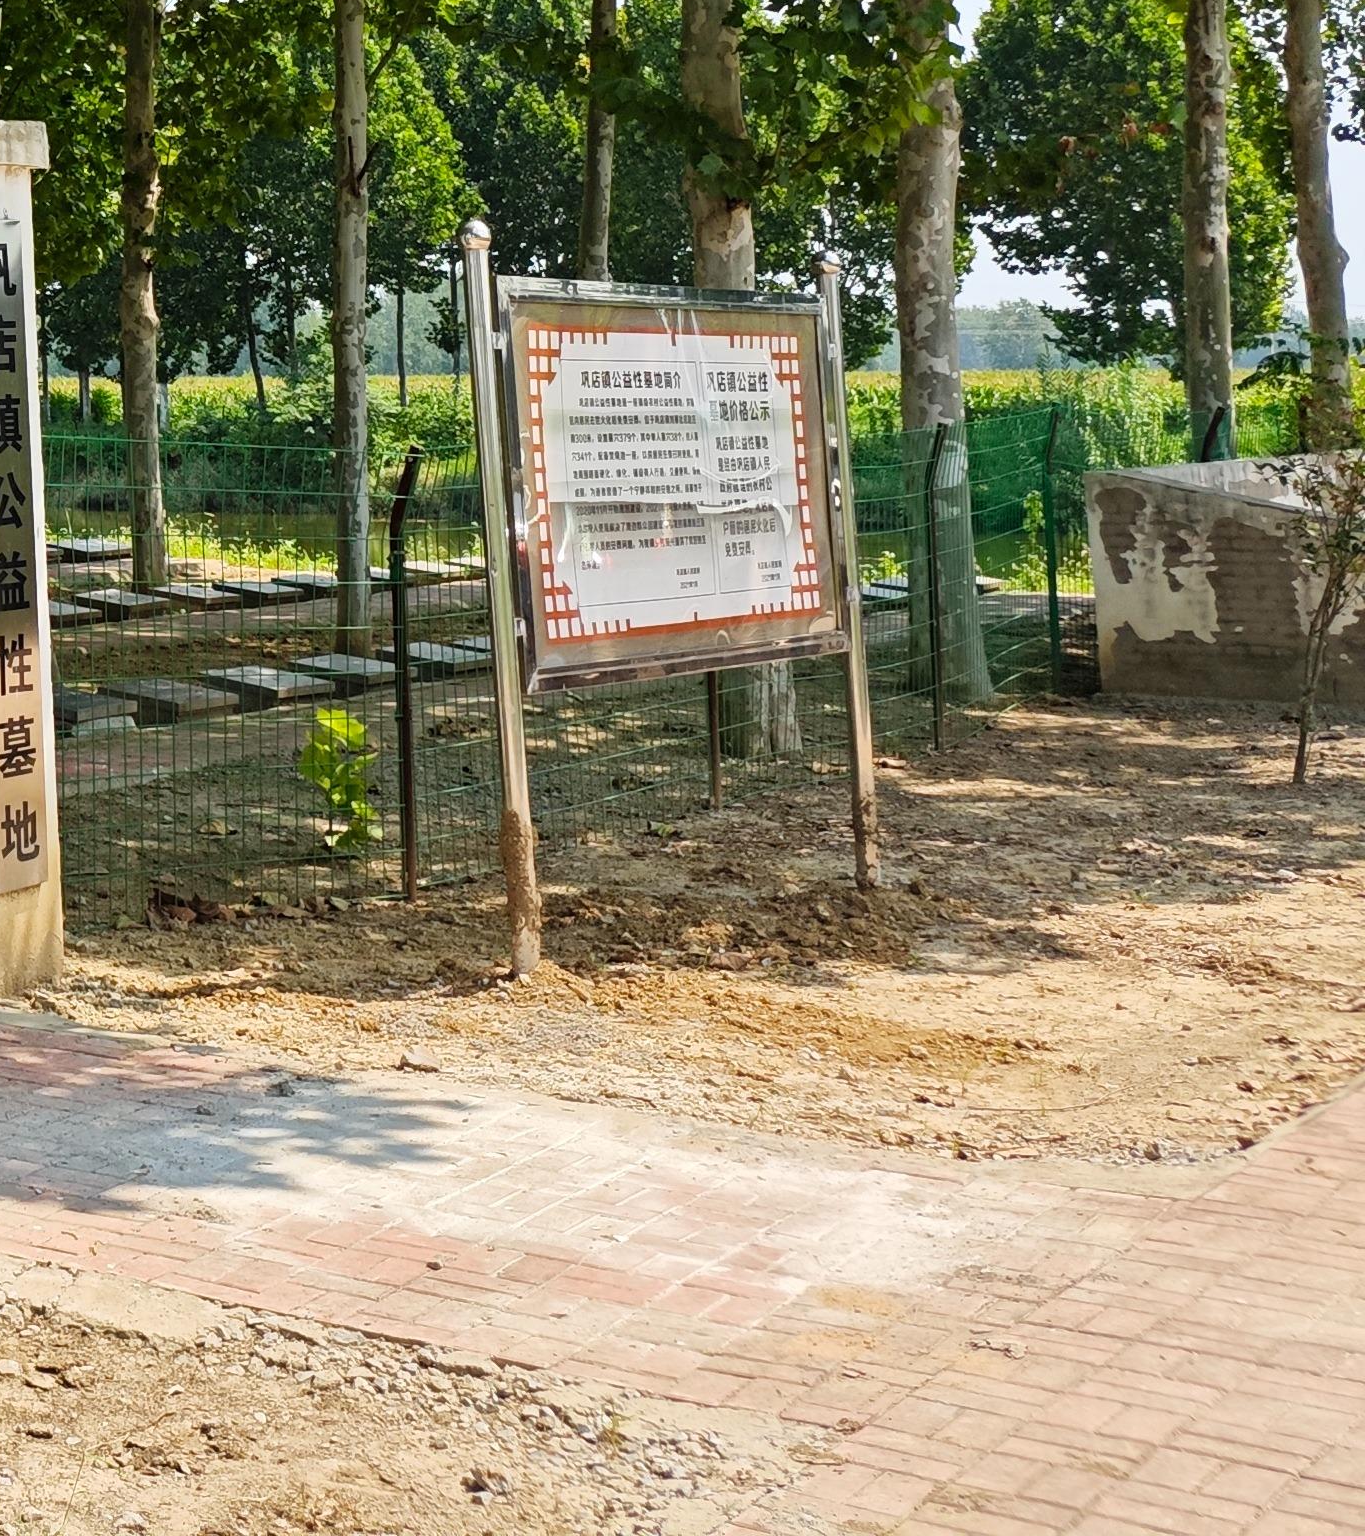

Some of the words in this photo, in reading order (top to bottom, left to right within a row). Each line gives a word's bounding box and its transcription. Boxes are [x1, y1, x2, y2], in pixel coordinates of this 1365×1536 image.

[581, 371, 681, 389] 巩店镇公益性墓地简介
[707, 371, 768, 392] 巩店镇公益性
